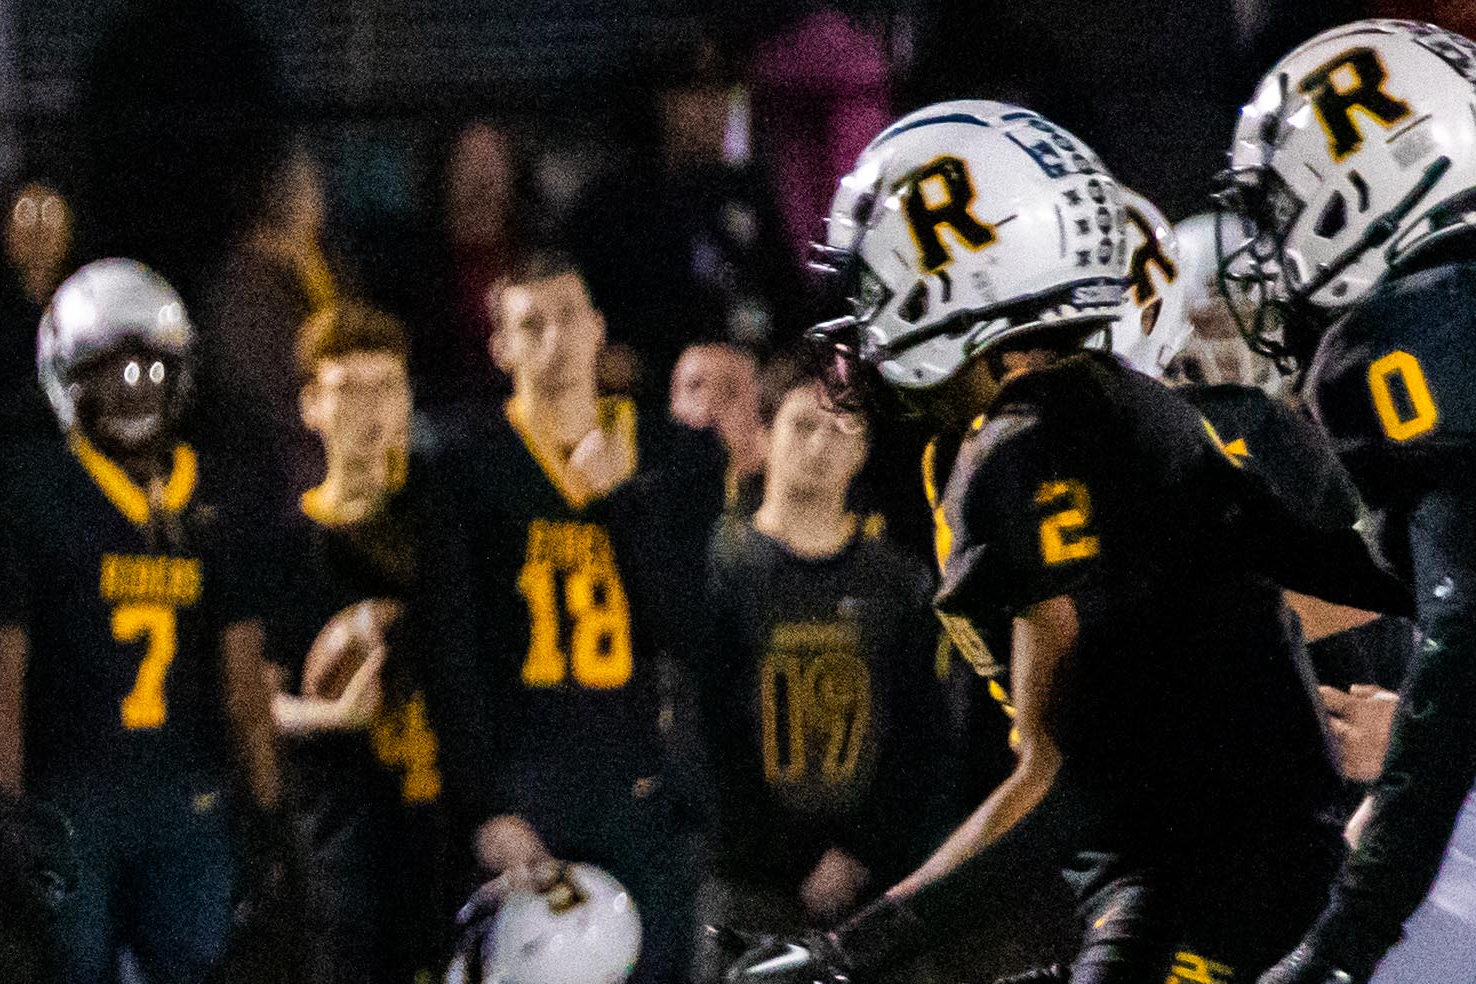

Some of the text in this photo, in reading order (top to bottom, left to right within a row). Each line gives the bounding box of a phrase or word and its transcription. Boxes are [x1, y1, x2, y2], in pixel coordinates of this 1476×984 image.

[1299, 46, 1414, 164] R
[890, 153, 1001, 274] R
[1367, 349, 1439, 443] 0
[1032, 479, 1101, 566] 2
[109, 604, 180, 731] 7
[515, 560, 634, 691] 18
